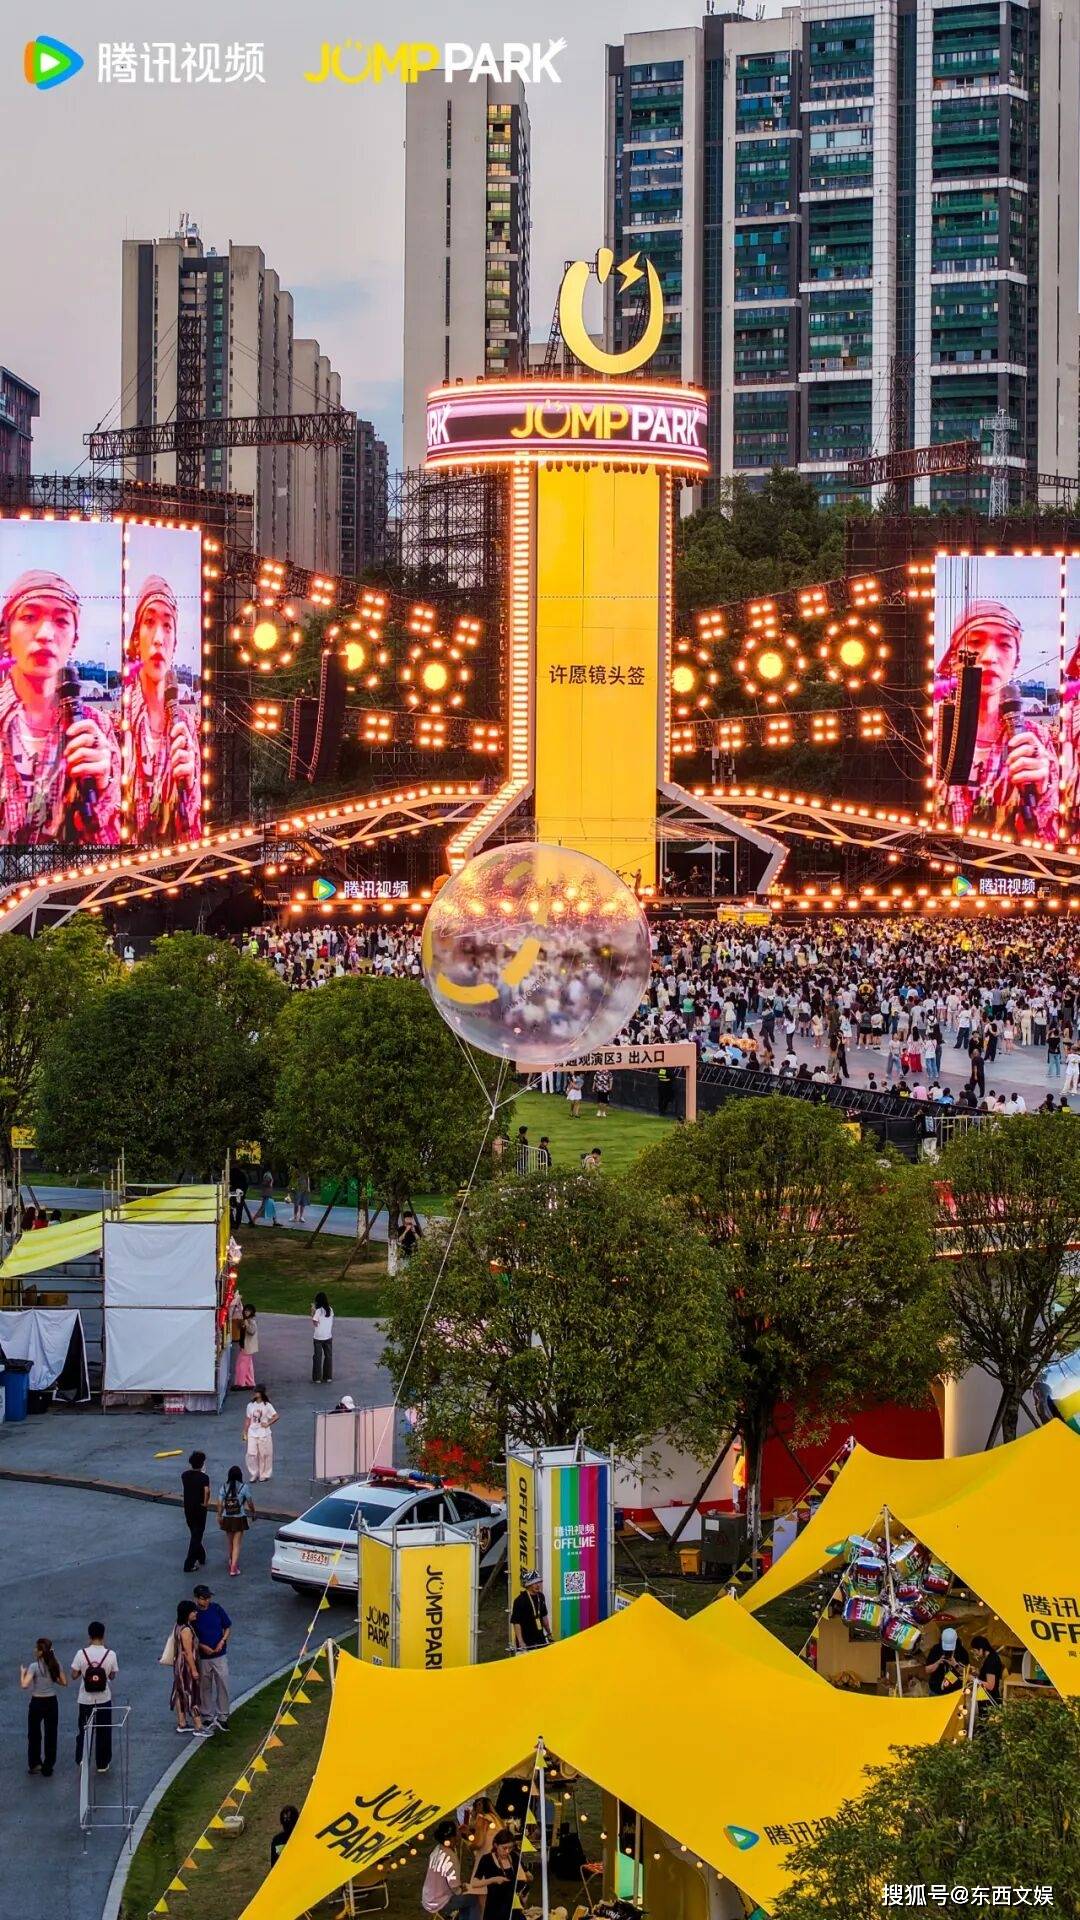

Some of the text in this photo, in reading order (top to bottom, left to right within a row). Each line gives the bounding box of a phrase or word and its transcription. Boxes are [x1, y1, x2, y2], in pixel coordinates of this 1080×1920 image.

[427, 403, 452, 446] RK
[510, 399, 700, 447] JUMP PARK
[549, 664, 645, 686] 许愿镜头签
[343, 880, 409, 899] 腾讯视频
[979, 878, 1036, 895] 腾讯视频
[628, 1050, 665, 1064] 出入口
[554, 1524, 595, 1537] 腾讯视频
[554, 1536, 596, 1550] OFFLINE
[425, 1565, 445, 1626] JUMP
[1023, 1593, 1080, 1618] 腾讯
[366, 1605, 390, 1629] JUMP
[367, 1624, 390, 1649] PARK
[355, 1784, 441, 1832] JUMP
[315, 1812, 403, 1864] PARK
